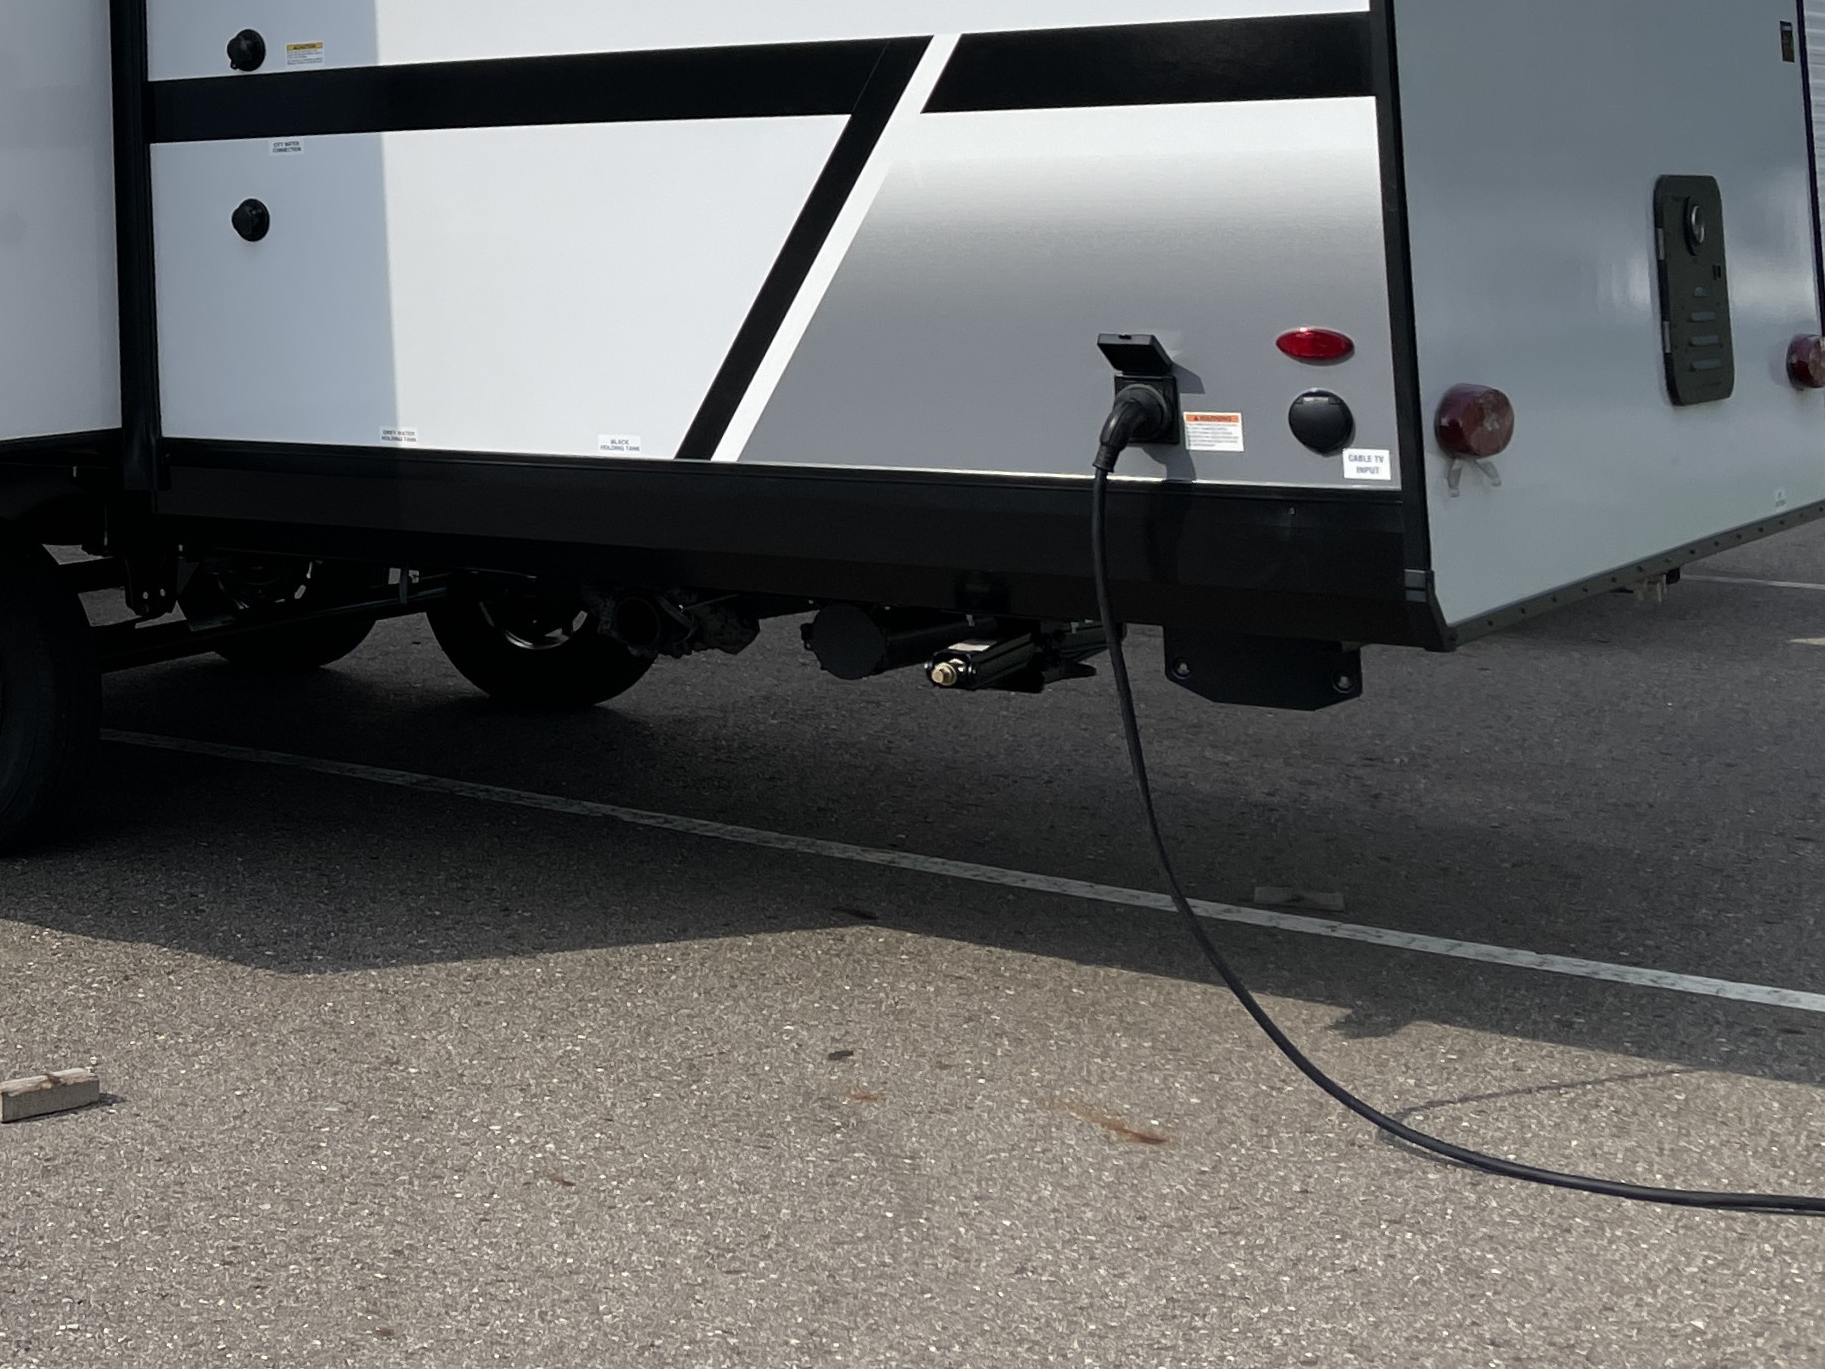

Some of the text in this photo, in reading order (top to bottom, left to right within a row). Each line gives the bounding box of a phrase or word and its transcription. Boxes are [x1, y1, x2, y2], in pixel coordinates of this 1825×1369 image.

[1348, 454, 1385, 463] CABLE TV
[1356, 466, 1380, 474] INPUT
